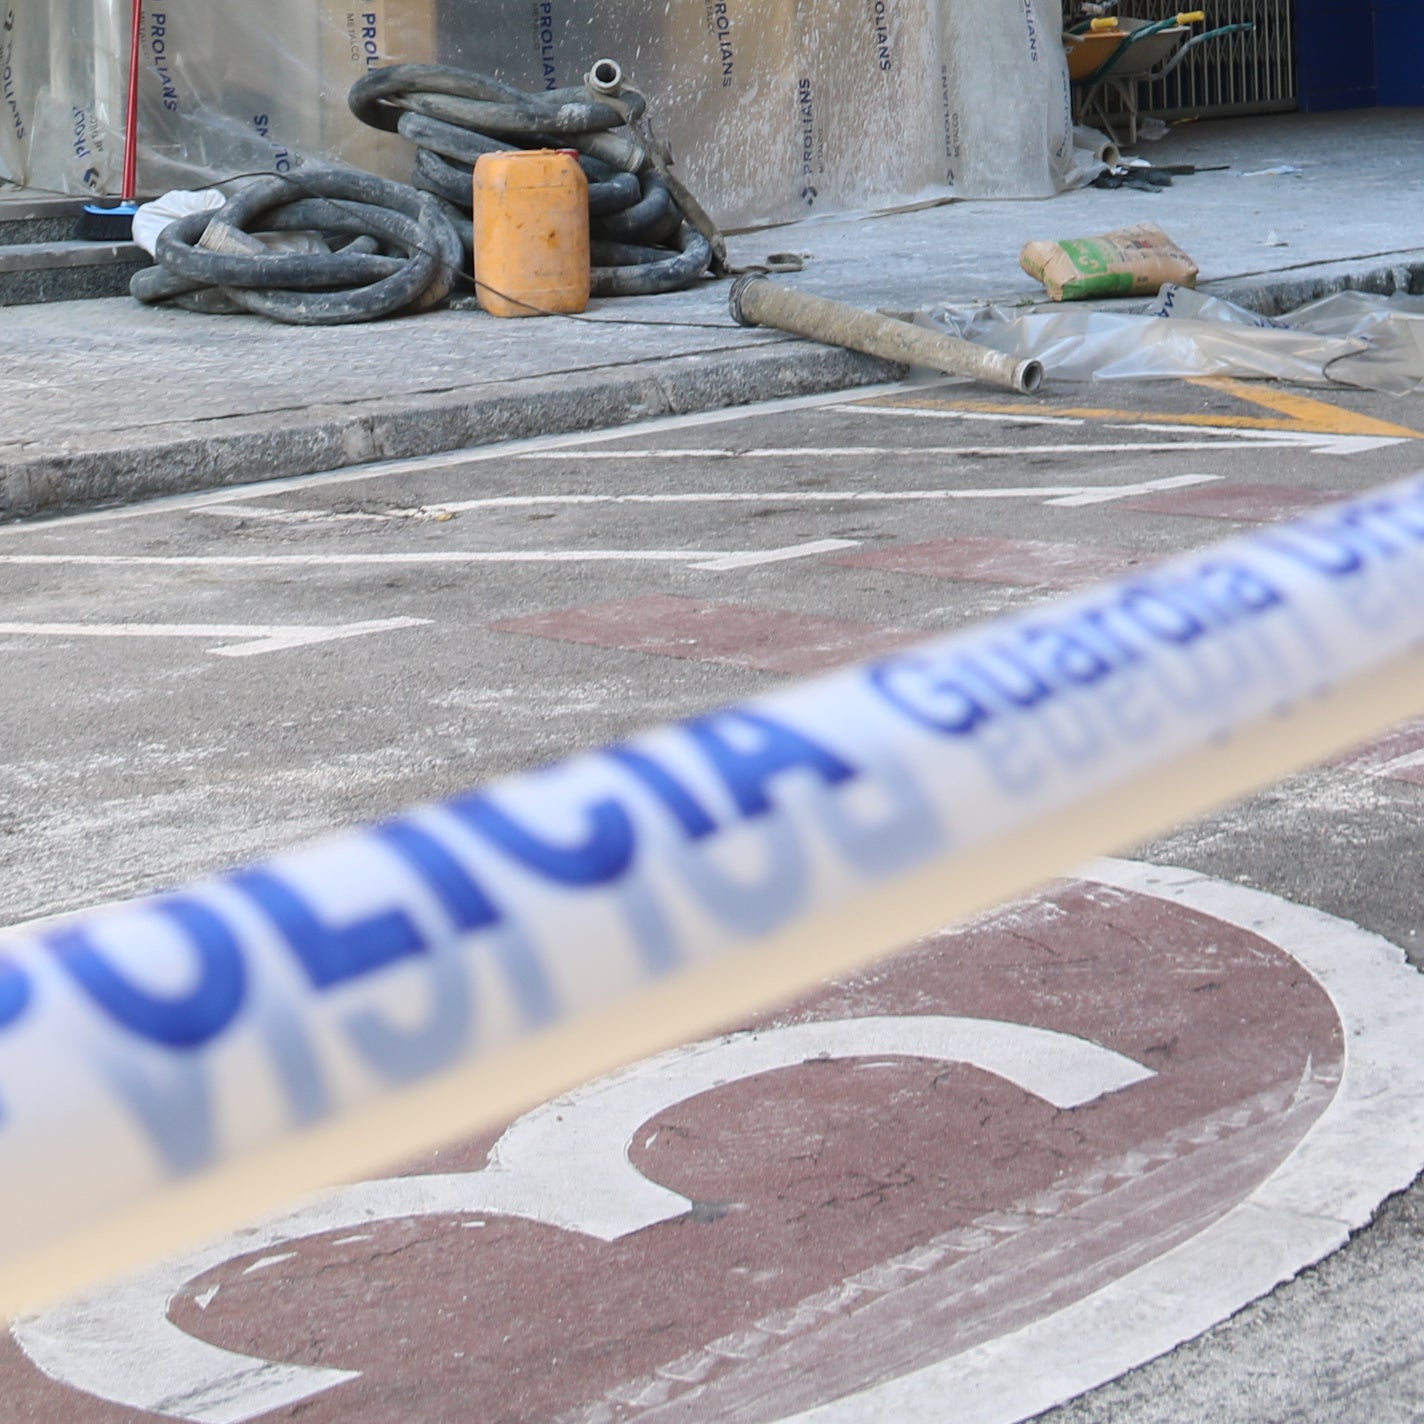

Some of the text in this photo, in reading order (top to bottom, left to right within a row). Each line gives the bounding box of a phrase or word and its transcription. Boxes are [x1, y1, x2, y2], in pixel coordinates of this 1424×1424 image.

[152, 12, 177, 112] PROLIANS
[346, 12, 359, 61] METALCO
[362, 12, 378, 73] PROLI
[540, 2, 556, 91] PROLIAN
[799, 78, 813, 176] PROLIANS
[941, 65, 951, 157] PROLIANS
